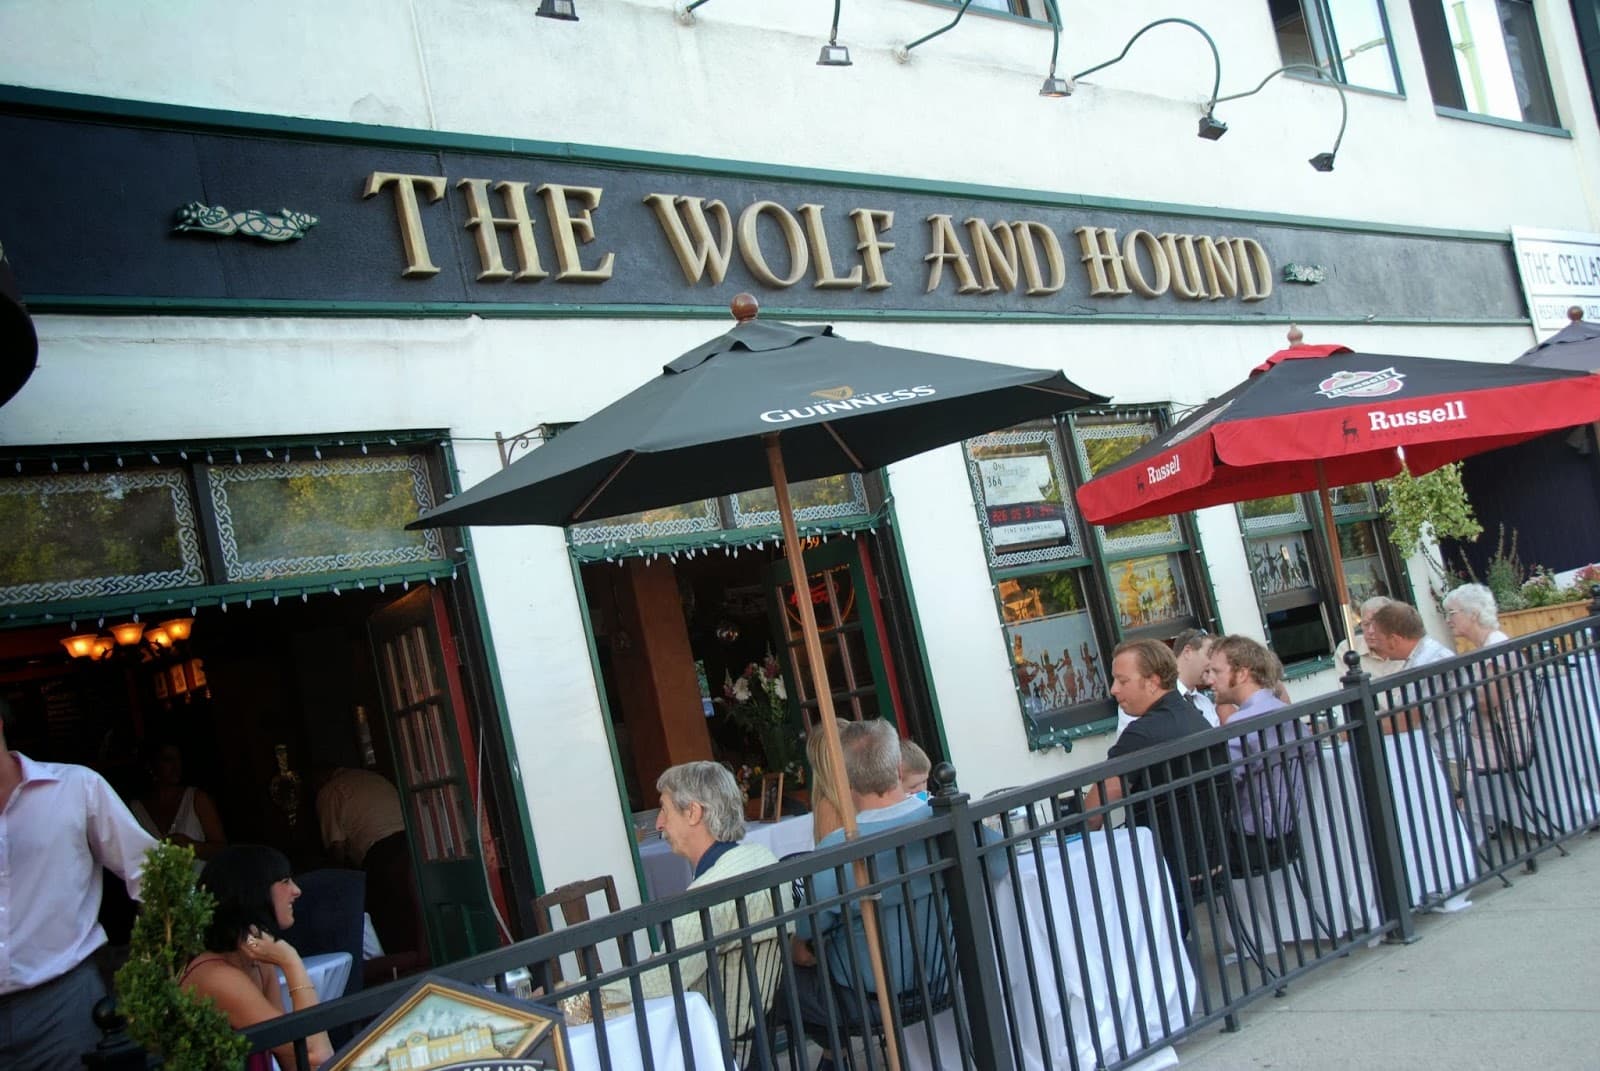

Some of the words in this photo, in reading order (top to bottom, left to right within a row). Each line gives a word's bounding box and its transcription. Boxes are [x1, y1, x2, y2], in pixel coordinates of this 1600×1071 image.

[362, 171, 615, 282] THE
[642, 193, 896, 292] WOLF
[923, 214, 1066, 296] AND
[1074, 226, 1273, 300] HOUND
[1523, 251, 1556, 285] THE
[760, 385, 936, 423] GUINNESS
[1368, 400, 1467, 431] Russell
[1147, 454, 1181, 484] Russell
